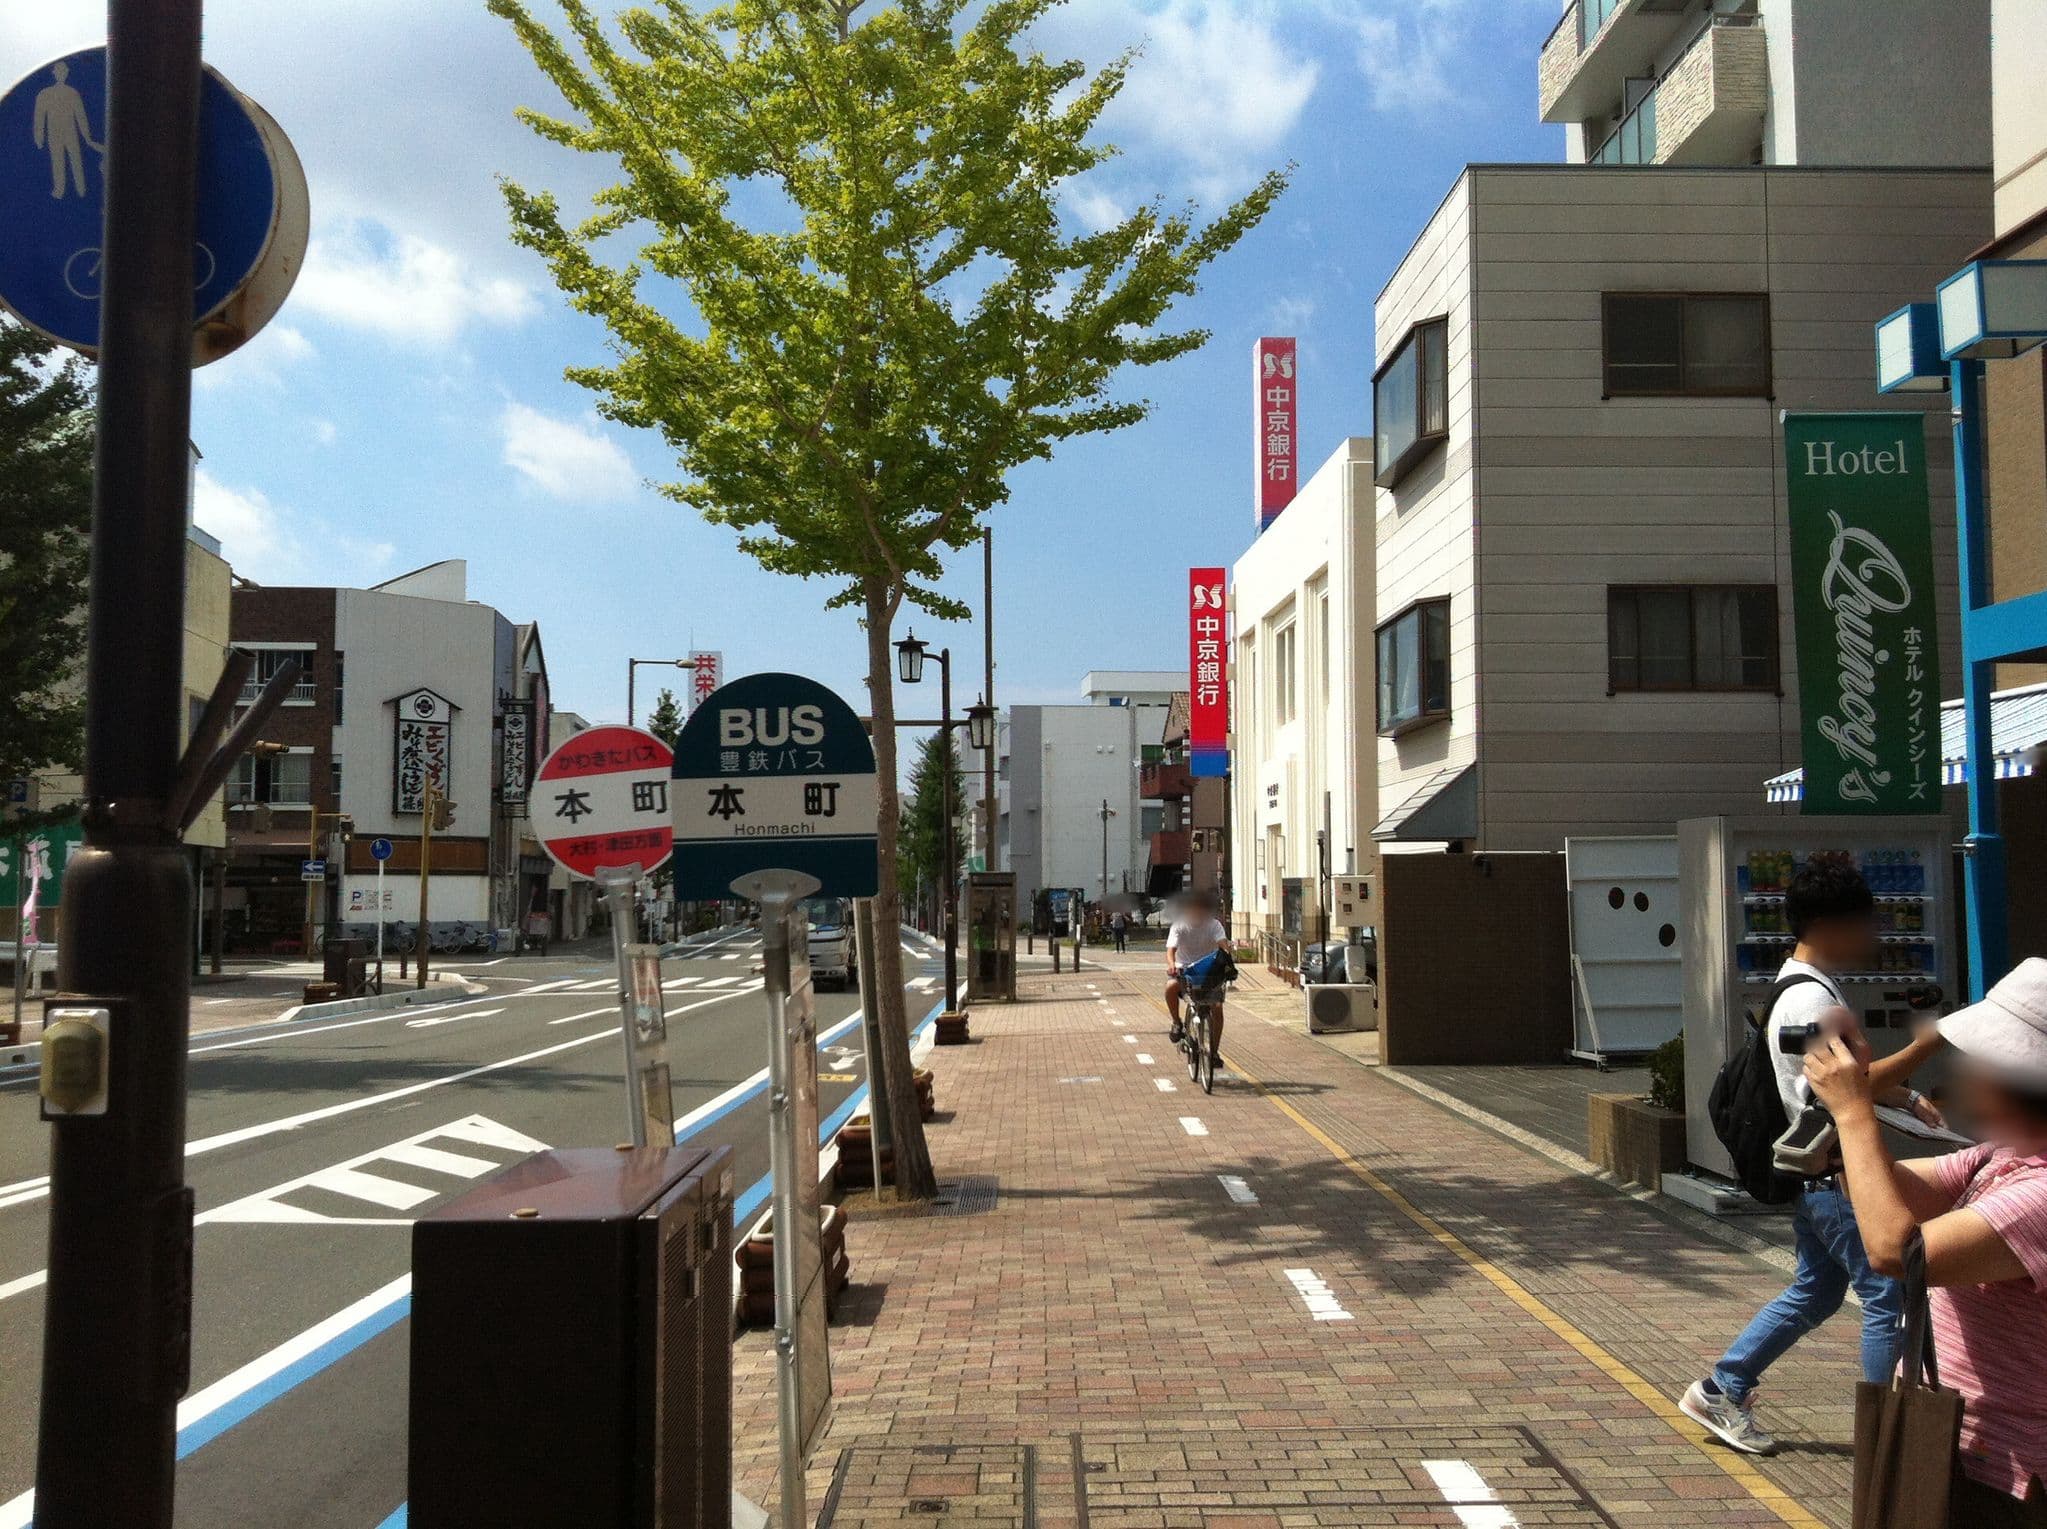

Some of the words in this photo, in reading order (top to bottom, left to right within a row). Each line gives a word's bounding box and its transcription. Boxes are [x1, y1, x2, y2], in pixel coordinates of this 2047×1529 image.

[1267, 386, 1291, 481] 中京銀行
[1803, 440, 1909, 476] Hotel
[1197, 616, 1219, 706] 中京銀行
[1817, 509, 1912, 804] Quincy's
[1903, 626, 1924, 682] ホテル
[719, 704, 825, 747] BUS
[1907, 688, 1926, 801] クインシーズ
[559, 746, 657, 769] かわきたバス
[720, 750, 826, 772] 豊鉄バス
[554, 781, 668, 823] 本町
[708, 782, 841, 821] 本町
[734, 822, 815, 836] Honmachi
